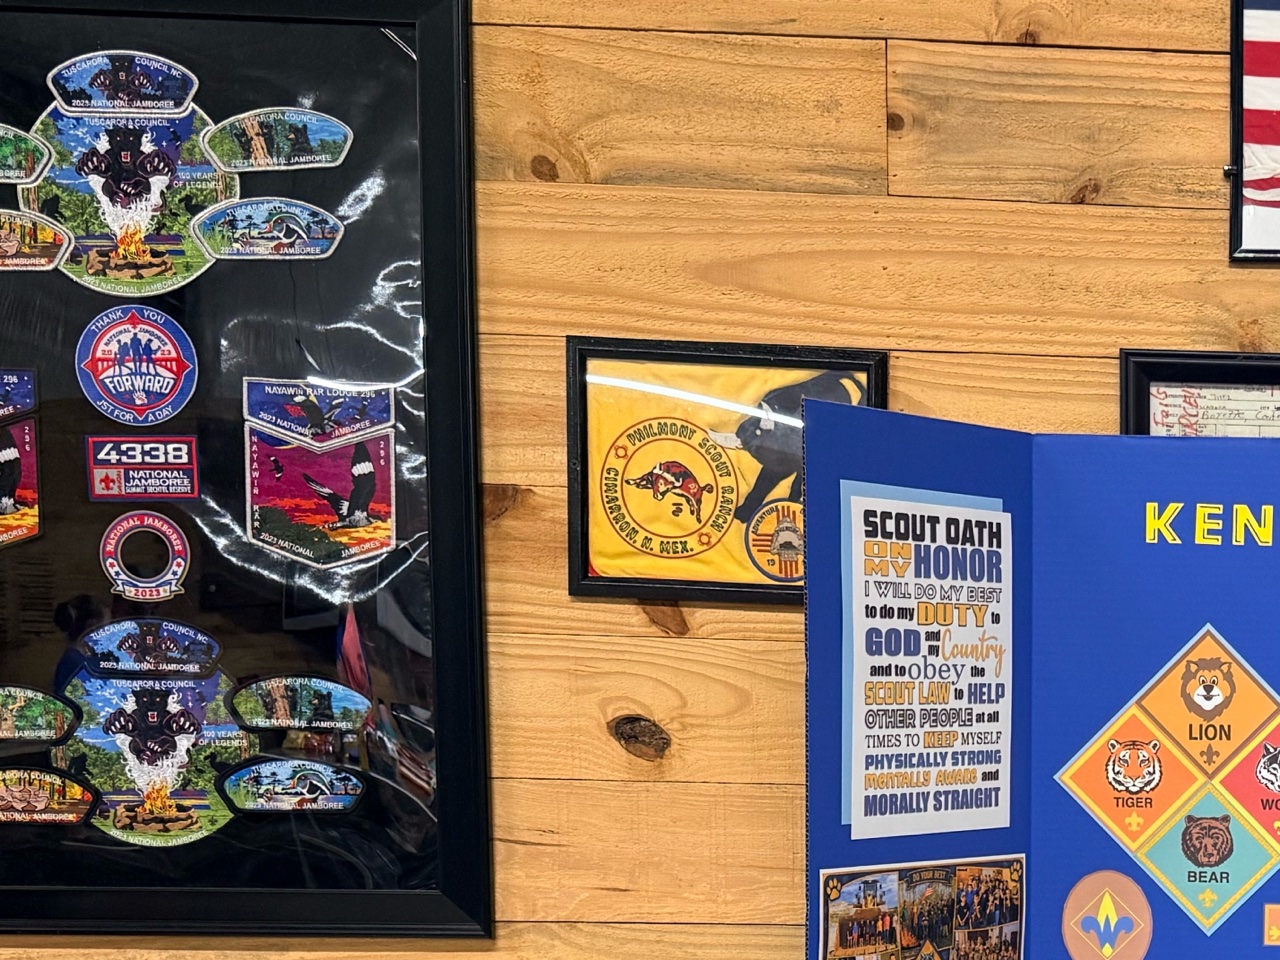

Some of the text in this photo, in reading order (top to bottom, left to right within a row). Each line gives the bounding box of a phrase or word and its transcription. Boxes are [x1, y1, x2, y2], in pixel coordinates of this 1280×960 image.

[91, 309, 165, 333] THANK YOU
[103, 375, 175, 394] FORWARD
[97, 443, 189, 463] 4338
[129, 470, 187, 478] NATIONAL
[626, 422, 734, 532] PHILMONT SCOUT RANCH
[863, 509, 1002, 549] SCOUT OATH
[660, 541, 694, 554] MEX.
[864, 540, 1002, 583] ON HONOR
[864, 559, 911, 578] MY
[865, 581, 1002, 603] I WILL DO MY BEST
[865, 601, 1000, 627] to do my DUTY to
[865, 627, 1006, 678] GOD and my Country
[870, 655, 985, 685] and to obey the
[864, 681, 1005, 705] SCOUT LAW to HELP
[865, 708, 999, 729] OTHER PEOPLE at all
[865, 731, 1002, 749] TIMES TO KEEP MYSELF
[1188, 724, 1232, 742] LION
[865, 749, 1002, 771] PHYSICALLY STRONG
[981, 769, 999, 782] and
[864, 786, 1000, 817] MORALLY STRAIGHT
[1113, 796, 1153, 810] TIGER
[1186, 870, 1230, 884] BEAR
